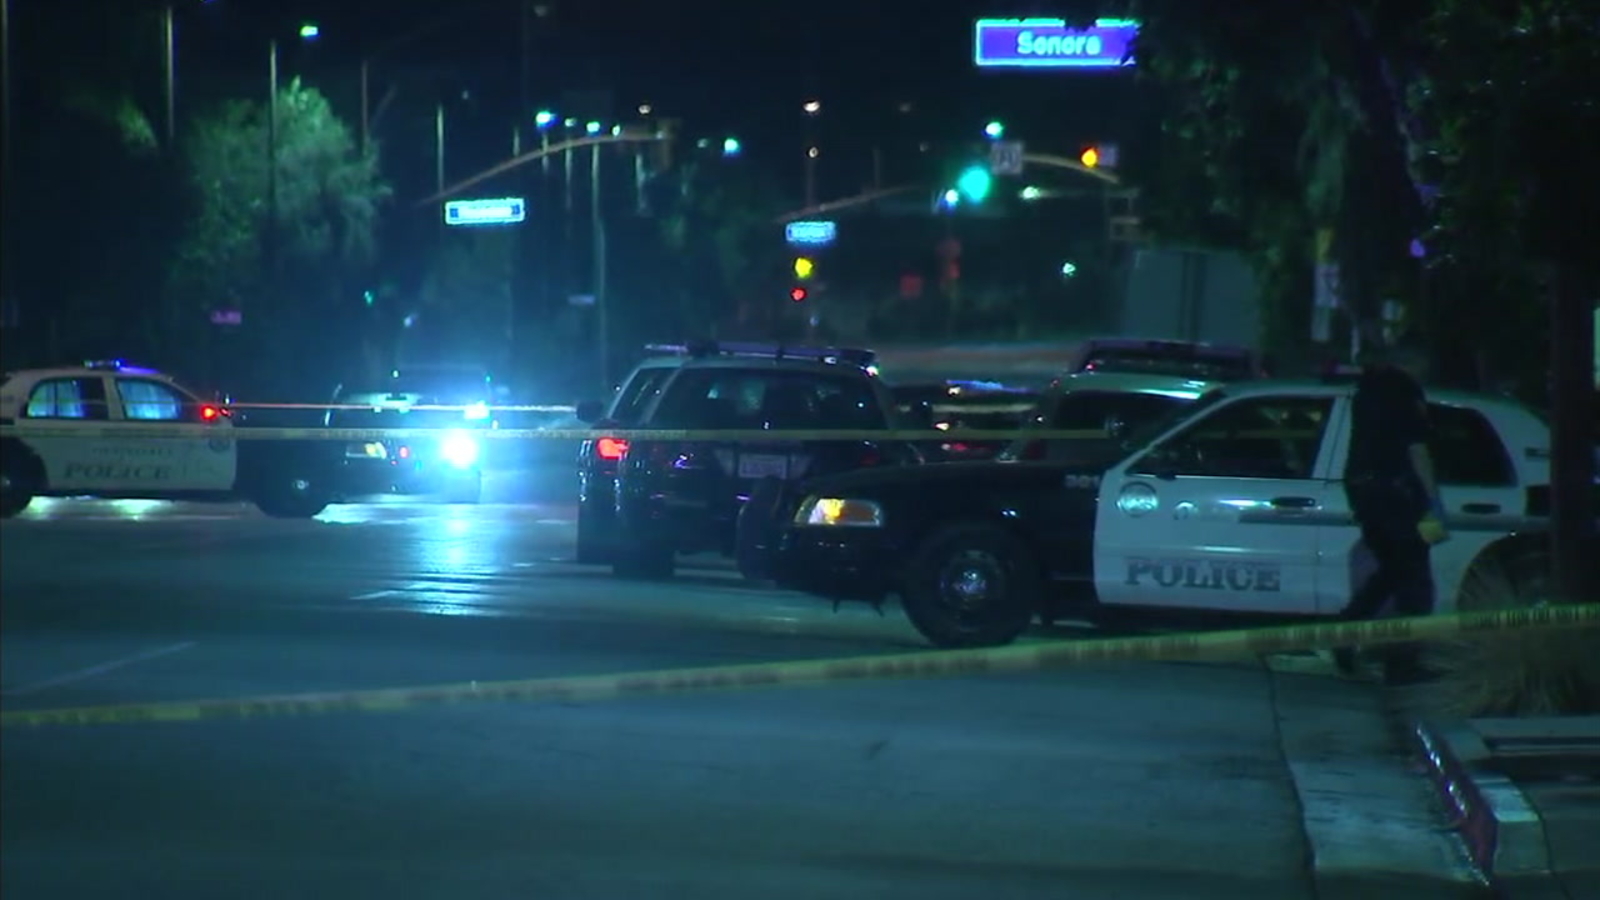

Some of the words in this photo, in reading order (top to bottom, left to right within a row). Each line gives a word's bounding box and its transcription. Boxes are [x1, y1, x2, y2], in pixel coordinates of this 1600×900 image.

[1017, 30, 1101, 56] Sonora
[63, 461, 173, 481] POLICE
[1123, 556, 1281, 592] POLICE
